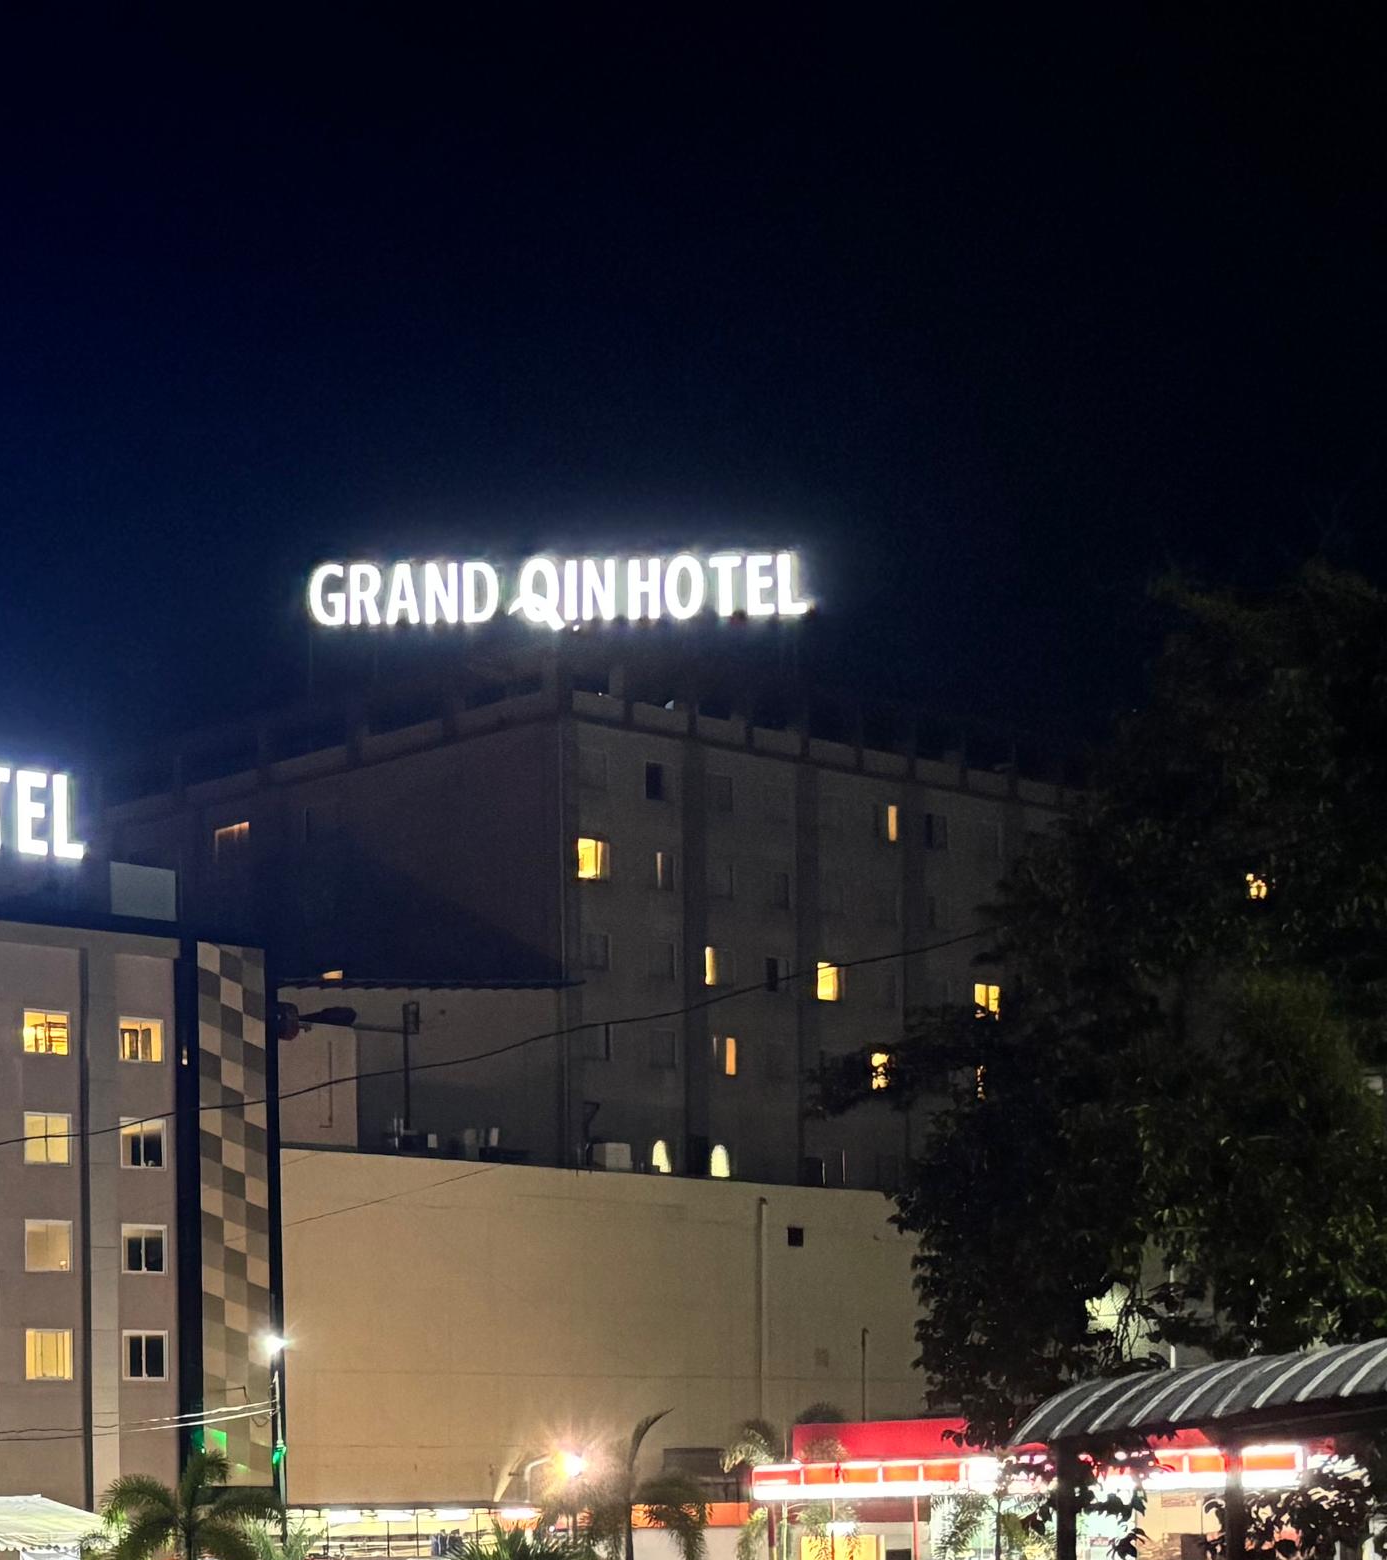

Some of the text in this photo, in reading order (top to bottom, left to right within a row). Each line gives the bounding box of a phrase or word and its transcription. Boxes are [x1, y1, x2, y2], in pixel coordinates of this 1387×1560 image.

[308, 553, 808, 631] GRAND QIN HOTEL
